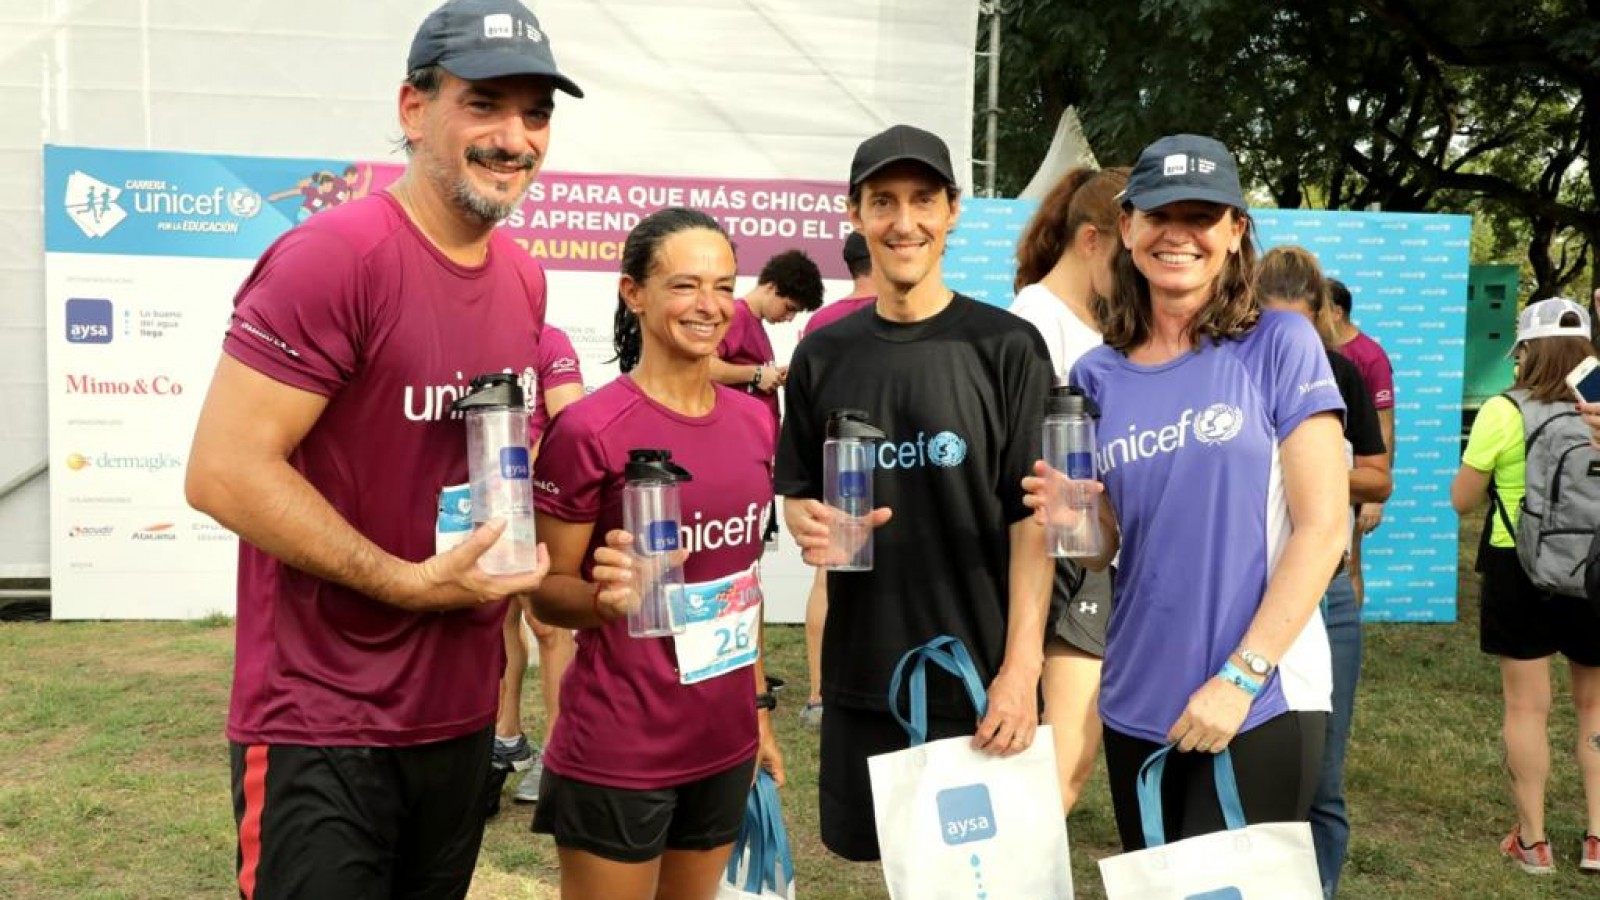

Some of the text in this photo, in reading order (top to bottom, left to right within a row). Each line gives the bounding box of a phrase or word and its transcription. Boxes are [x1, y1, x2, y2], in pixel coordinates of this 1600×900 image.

[134, 185, 224, 215] unicef
[551, 183, 623, 204] PARA
[627, 185, 684, 208] QUE
[689, 185, 746, 210] MÁS
[751, 190, 849, 213] CHICAS
[724, 216, 797, 237] TODO
[802, 219, 833, 239] EL
[71, 324, 109, 340] aysa
[1096, 408, 1193, 476] unicef
[681, 502, 757, 553] nicef
[714, 621, 749, 657] 26
[946, 816, 989, 838] aysa
